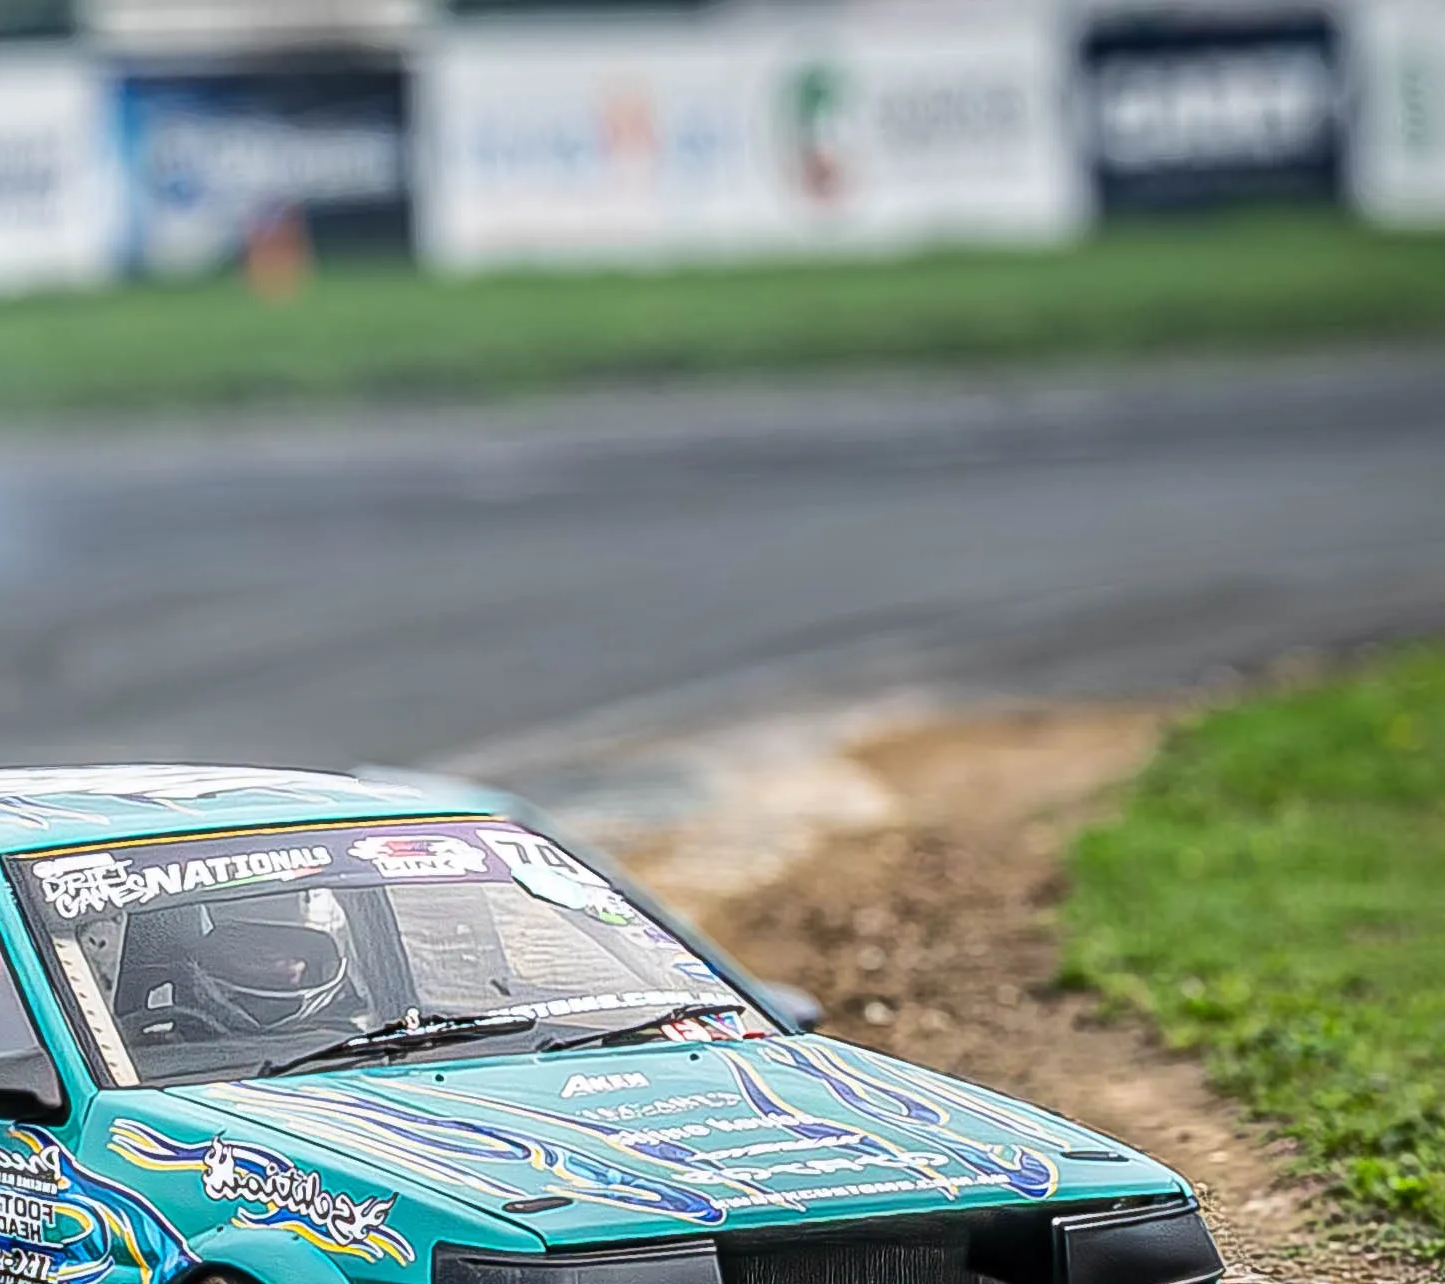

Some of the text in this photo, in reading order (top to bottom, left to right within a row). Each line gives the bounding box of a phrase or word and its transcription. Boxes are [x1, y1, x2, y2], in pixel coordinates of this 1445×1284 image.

[41, 859, 132, 903] DRIFT
[145, 846, 333, 894] NATIONALS
[55, 873, 148, 919] GAMES
